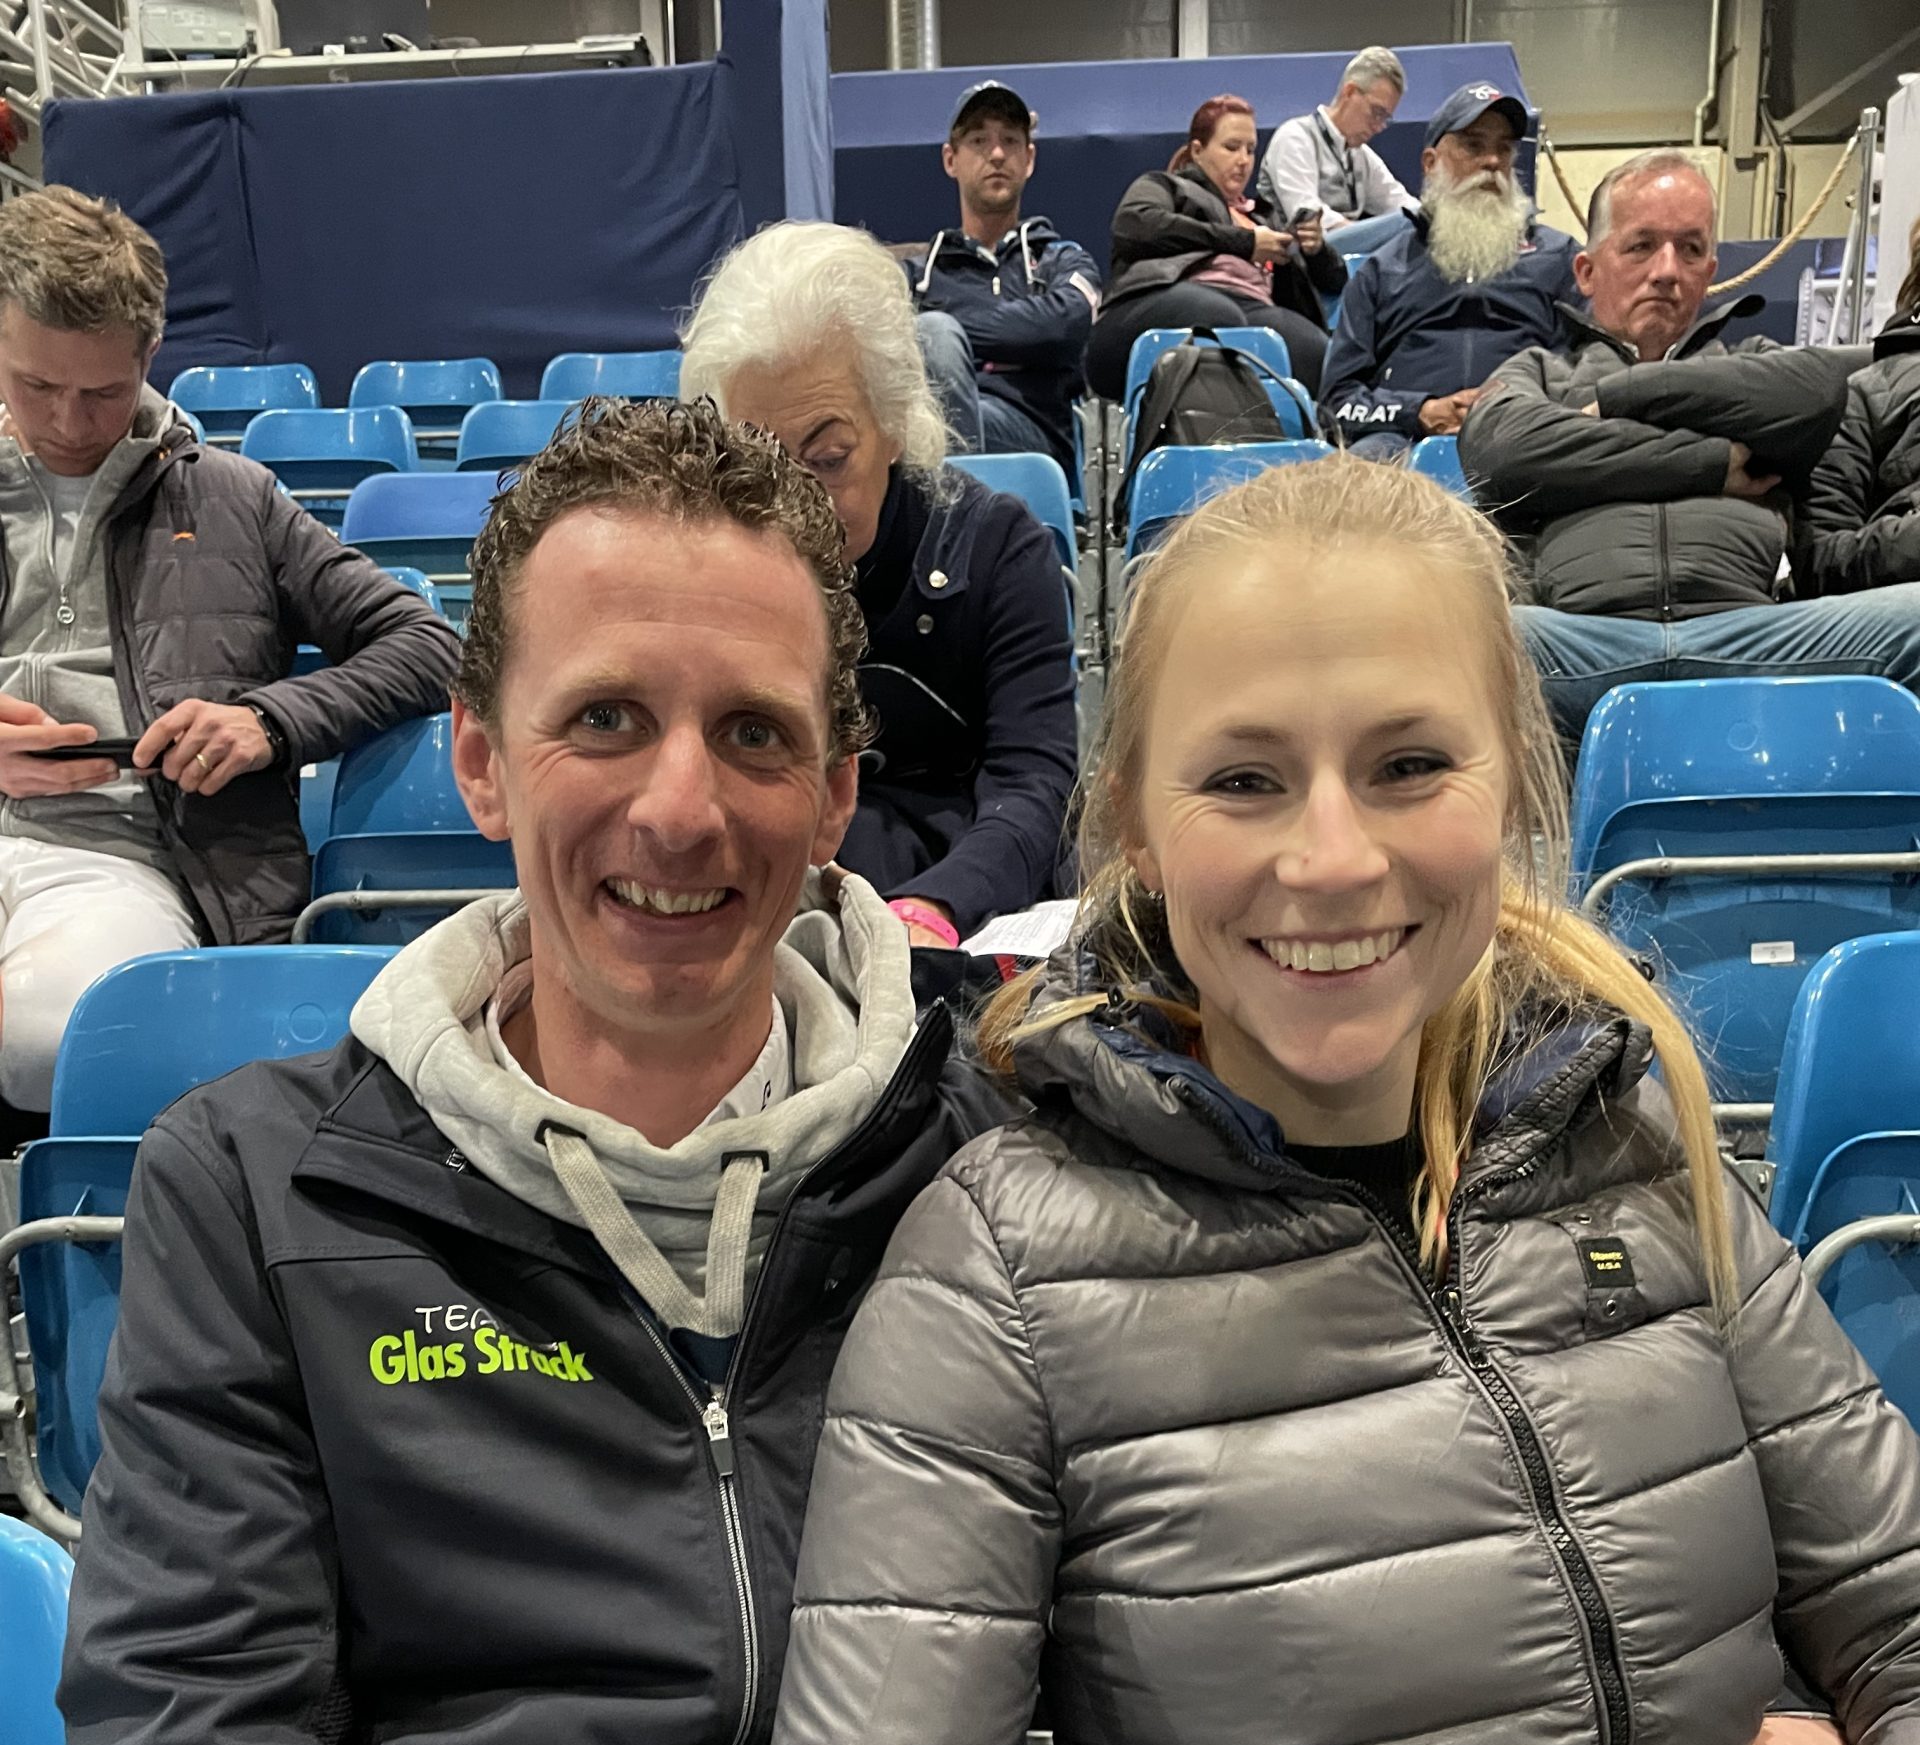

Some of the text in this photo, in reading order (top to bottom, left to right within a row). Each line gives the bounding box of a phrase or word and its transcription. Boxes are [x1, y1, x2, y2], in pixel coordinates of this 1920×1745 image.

[1336, 402, 1402, 423] ARAT
[414, 1304, 500, 1334] TEA
[369, 1327, 594, 1386] Glas Strack
